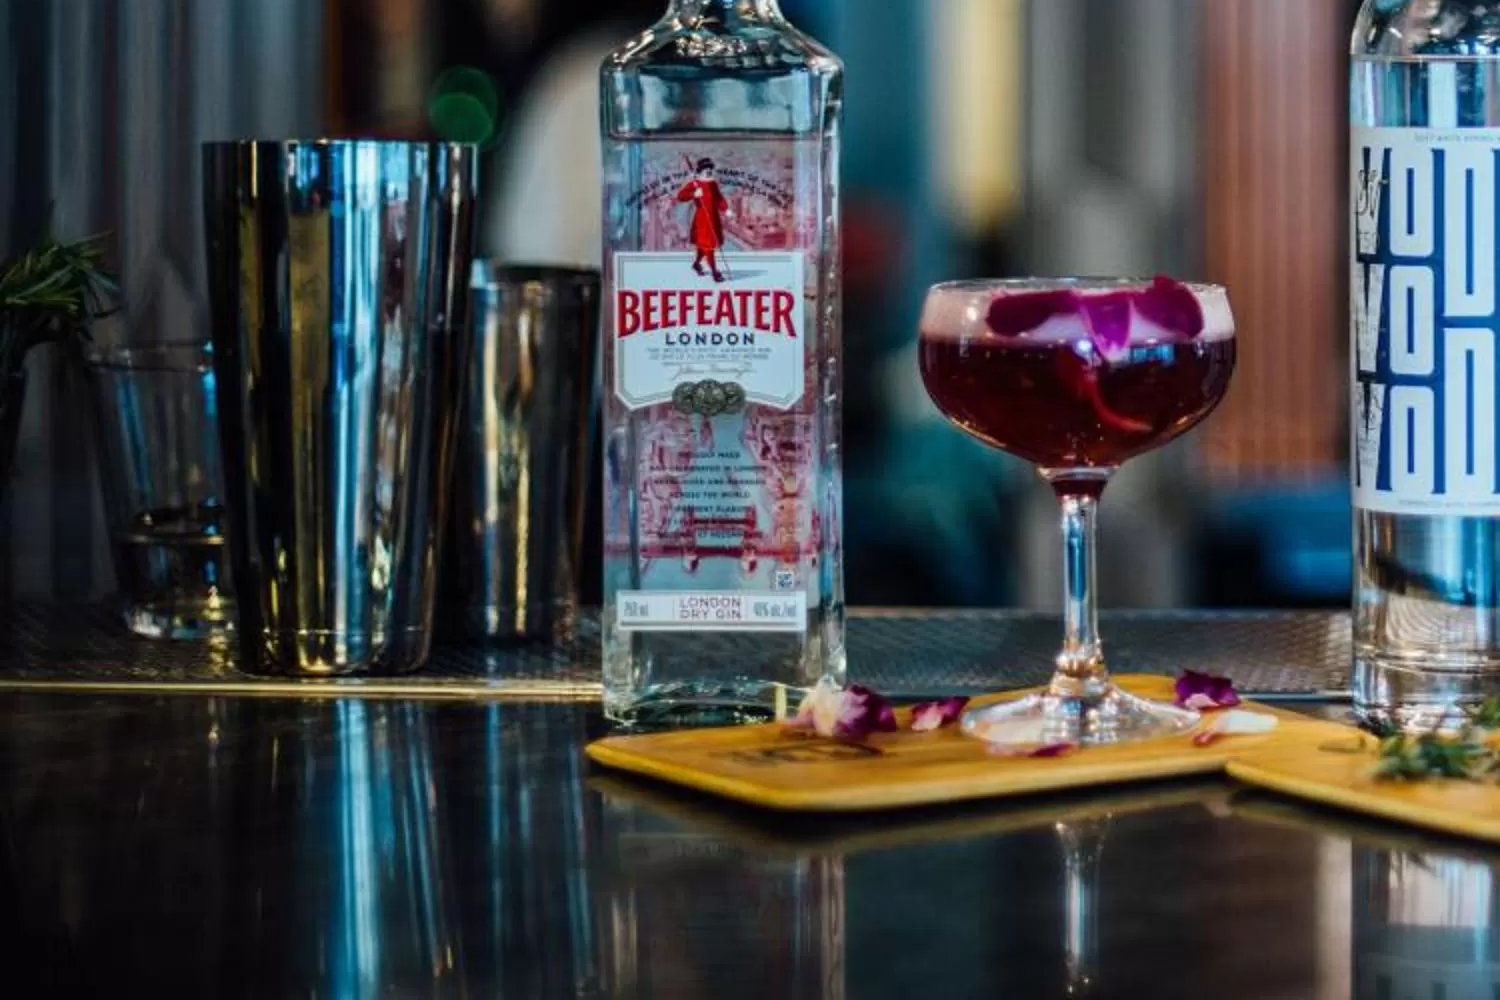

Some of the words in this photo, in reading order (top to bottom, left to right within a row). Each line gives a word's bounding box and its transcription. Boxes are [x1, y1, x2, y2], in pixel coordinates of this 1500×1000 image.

[617, 290, 797, 338] BEEFEATER
[665, 332, 755, 346] LONDON
[679, 596, 743, 608] LONDON
[679, 609, 710, 620] DRY
[715, 609, 743, 620] GIN
